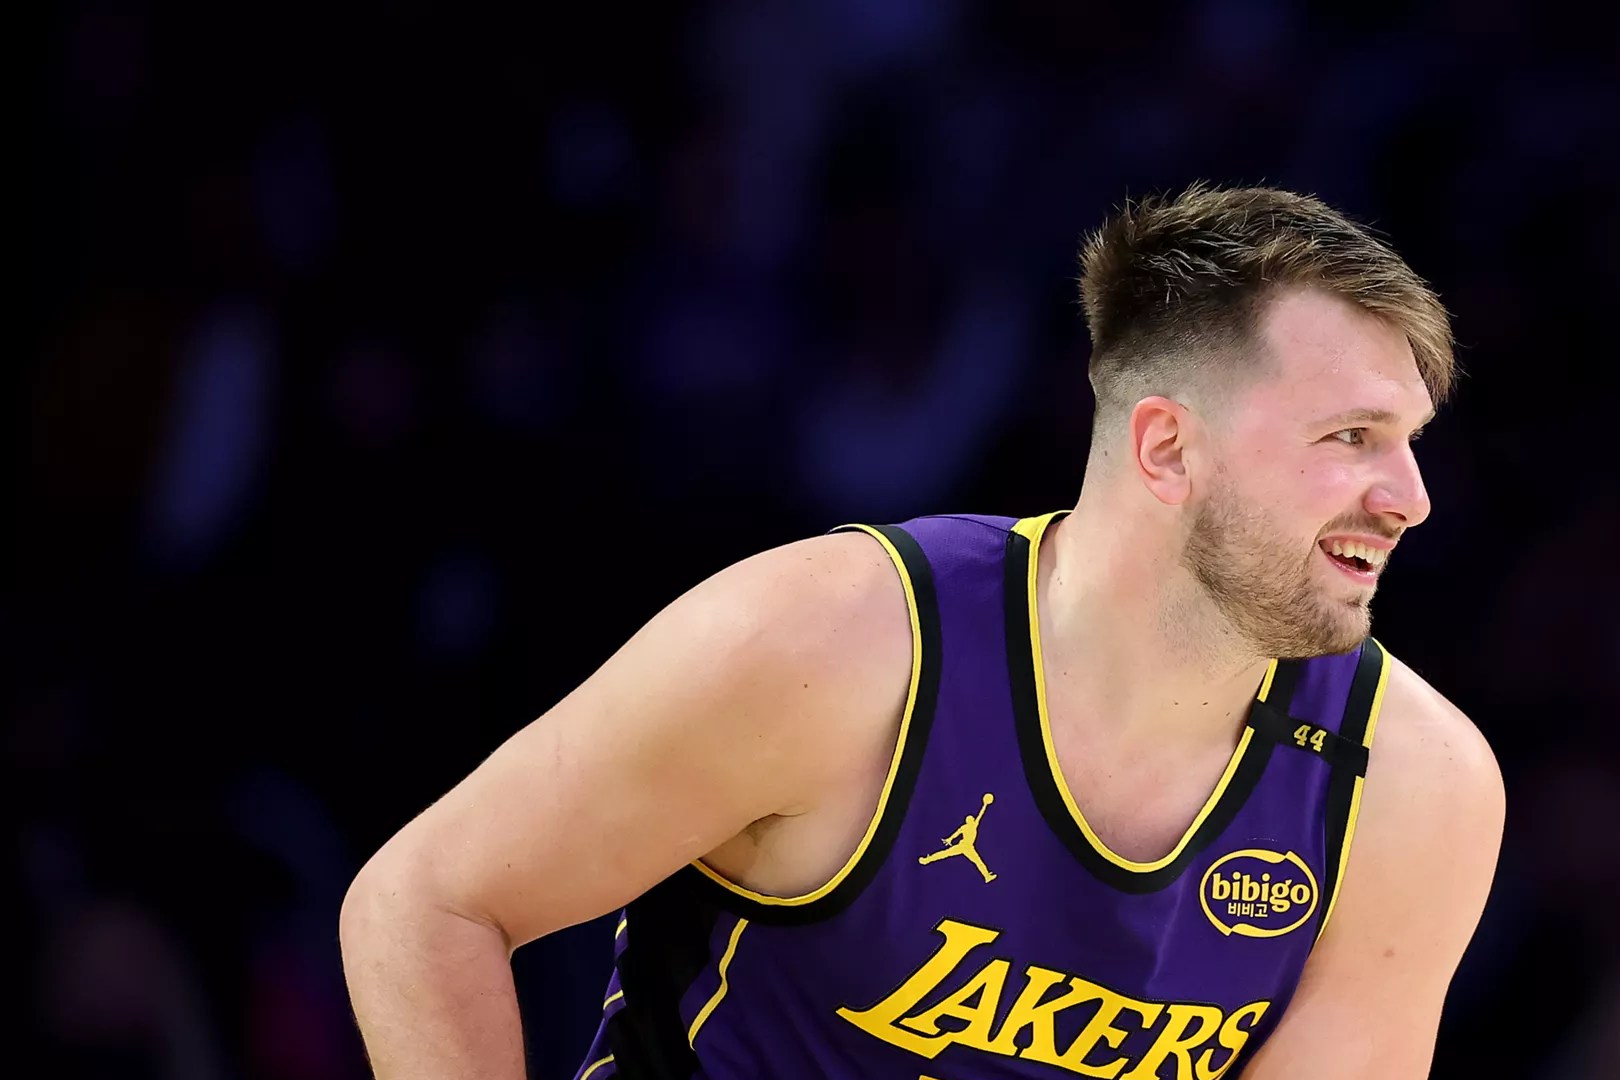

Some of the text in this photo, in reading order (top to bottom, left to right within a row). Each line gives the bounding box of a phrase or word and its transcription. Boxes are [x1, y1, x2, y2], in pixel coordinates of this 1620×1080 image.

[1294, 725, 1327, 752] 44
[1212, 872, 1310, 912] bibigo
[1228, 902, 1268, 917] 비비고
